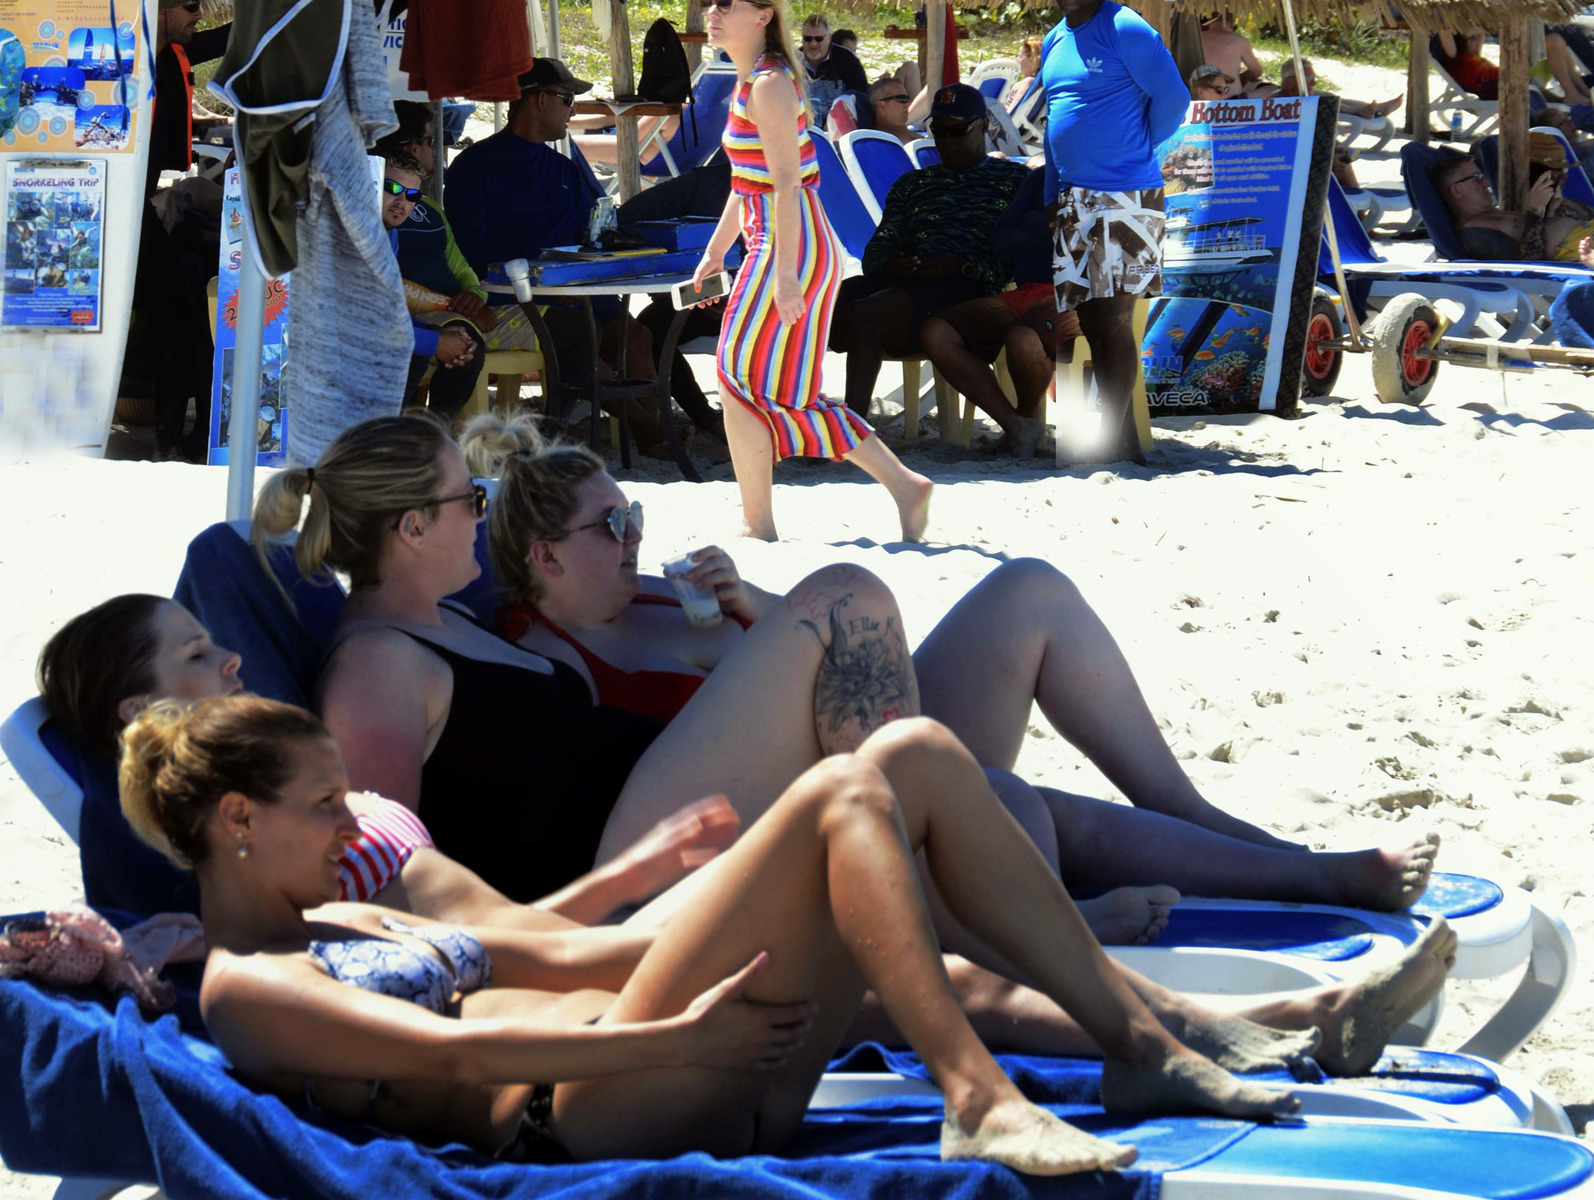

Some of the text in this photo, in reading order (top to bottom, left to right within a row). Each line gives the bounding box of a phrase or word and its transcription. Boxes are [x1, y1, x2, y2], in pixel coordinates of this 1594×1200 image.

[1190, 99, 1302, 125] Bottom Boat
[12, 177, 100, 187] SNORKELING TRIP
